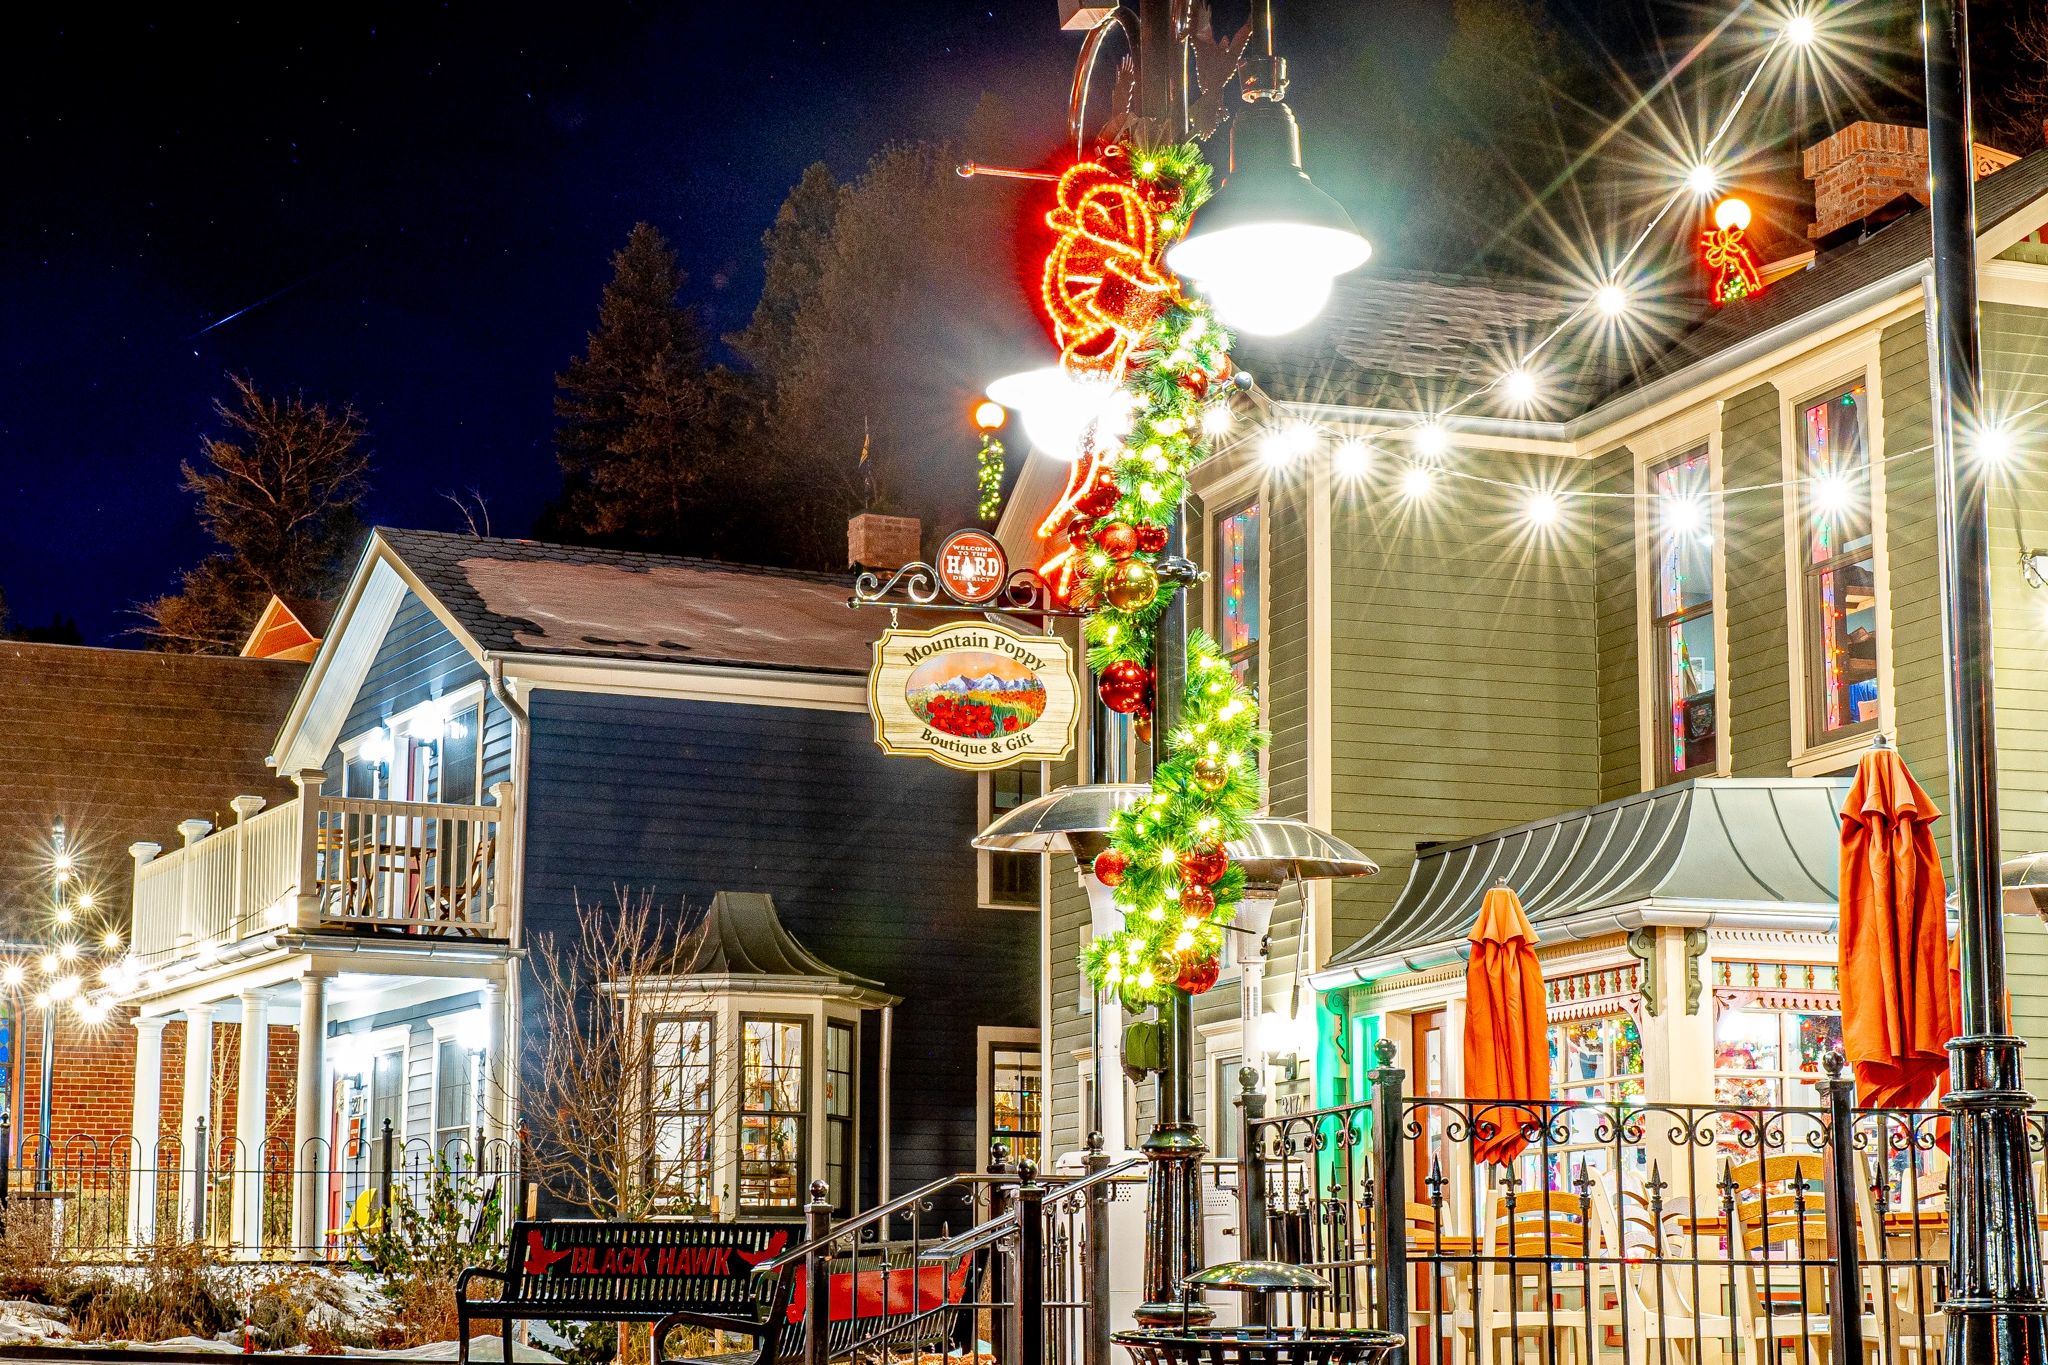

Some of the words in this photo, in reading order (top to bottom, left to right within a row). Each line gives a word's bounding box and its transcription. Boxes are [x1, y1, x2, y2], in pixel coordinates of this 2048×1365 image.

[947, 555, 999, 577] HARD
[903, 632, 989, 667] Mountain
[994, 635, 1047, 671] Poppy
[920, 727, 987, 758] Boutique
[991, 741, 1003, 754] &
[1005, 732, 1034, 751] Gift
[570, 1246, 650, 1275] BLACK
[656, 1246, 733, 1276] HAWK
